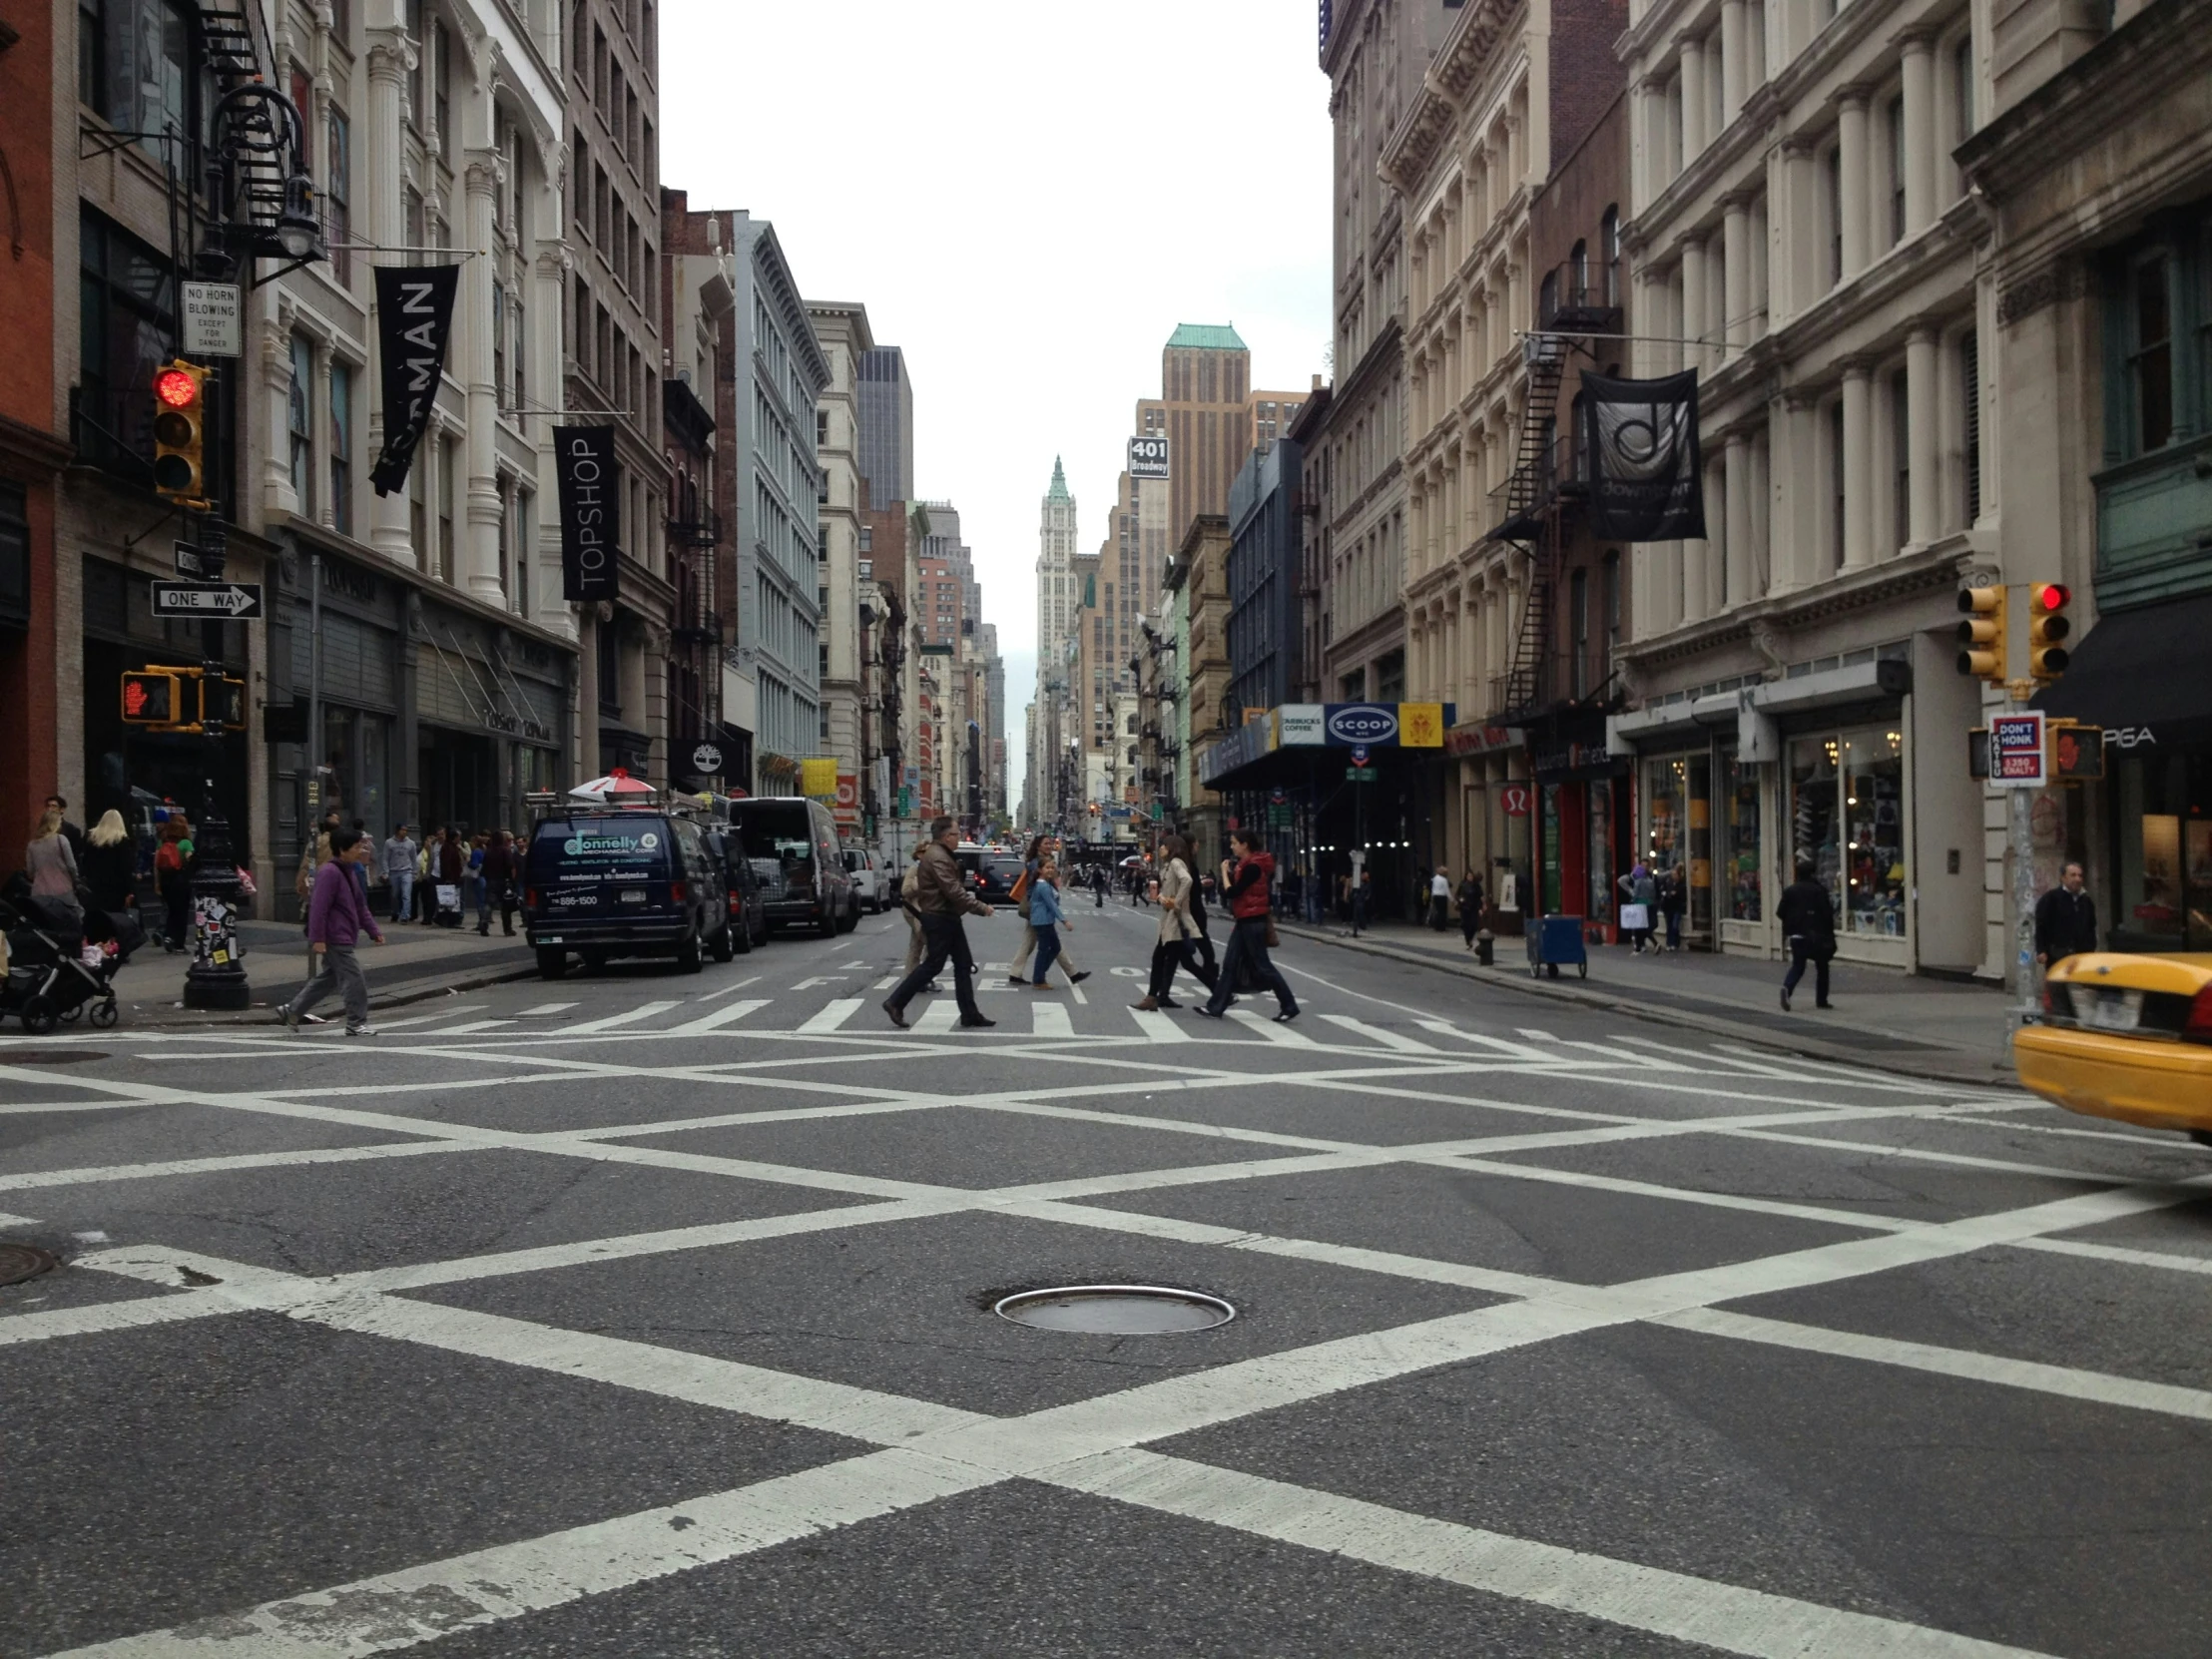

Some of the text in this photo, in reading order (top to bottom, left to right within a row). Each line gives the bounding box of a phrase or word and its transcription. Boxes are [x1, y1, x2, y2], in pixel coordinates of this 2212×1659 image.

[188, 288, 235, 301] NO HORN
[189, 303, 236, 316] BLOWING
[1132, 441, 1166, 457] 401
[1132, 459, 1167, 474] Broadway
[572, 438, 605, 591] TOPSHOP
[169, 592, 245, 608] ONE WAY
[1336, 720, 1391, 730] SCOOP
[1999, 723, 2033, 735] DON'T
[2000, 734, 2033, 746] HONK
[564, 830, 639, 856] donnelly
